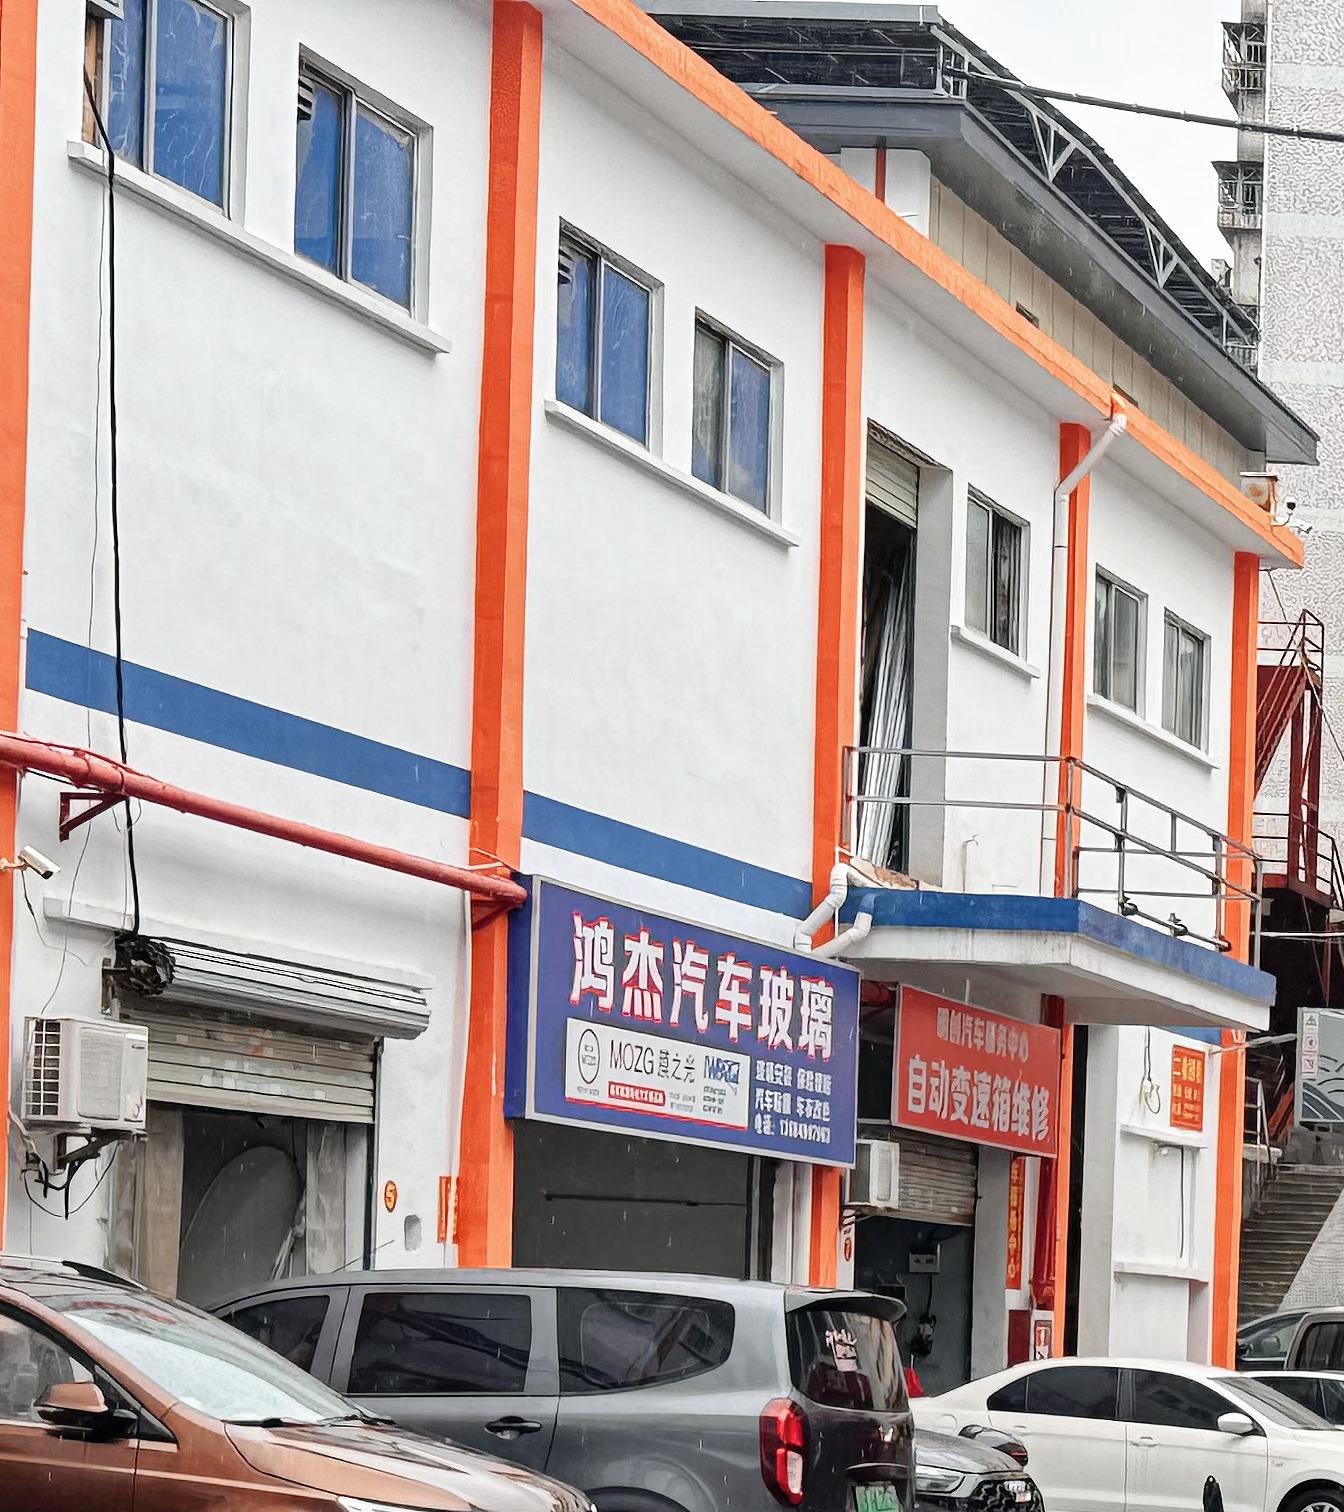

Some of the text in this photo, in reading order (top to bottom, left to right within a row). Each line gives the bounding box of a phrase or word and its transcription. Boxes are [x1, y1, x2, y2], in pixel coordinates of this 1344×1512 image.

[569, 911, 834, 1062] 鸿杰汽车玻璃
[610, 1039, 654, 1075] MOZG
[907, 1054, 1051, 1143] 自动变速箱维修
